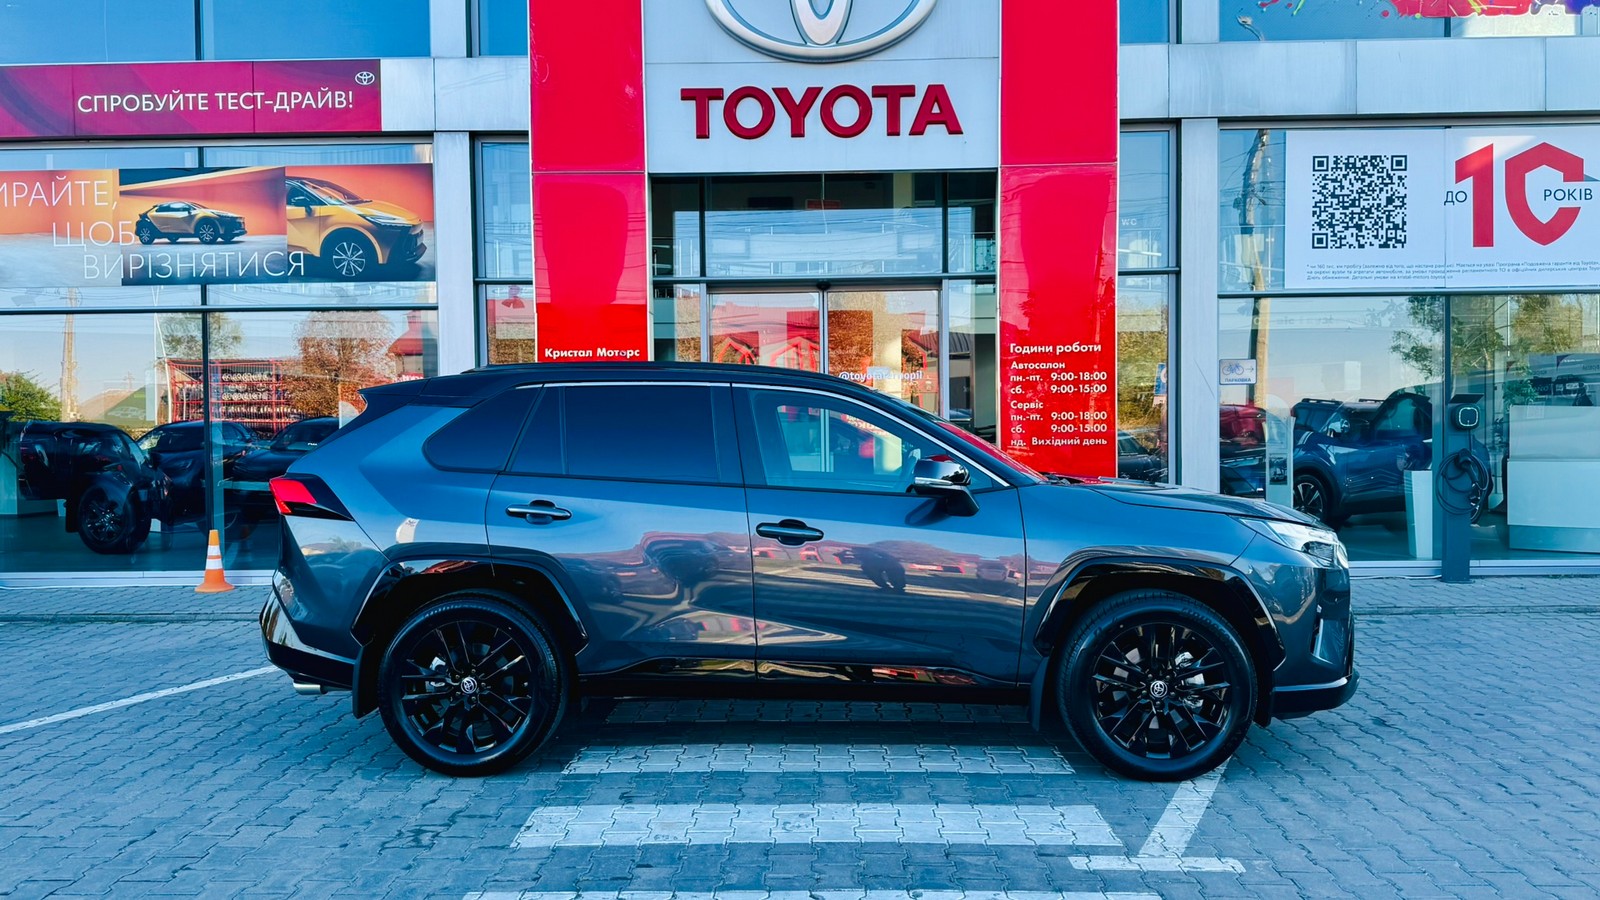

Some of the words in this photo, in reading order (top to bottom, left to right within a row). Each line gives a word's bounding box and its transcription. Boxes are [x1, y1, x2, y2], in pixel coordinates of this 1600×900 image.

[78, 89, 208, 114] СПРОБУЙТЕ
[214, 86, 353, 112] ТЕСТ-ДРАЙВ!
[680, 84, 964, 139] TOYOTA
[1444, 190, 1468, 206] ДО
[1455, 142, 1584, 248] 10
[1544, 188, 1593, 202] РОКІВ
[52, 220, 136, 252] ЩОБ
[83, 250, 305, 280] ВИРІЗНЯТИСЯ
[545, 348, 592, 359] Кристал
[596, 348, 640, 358] Моторс
[1010, 343, 1053, 354] Години
[1056, 342, 1101, 355] роботи
[1010, 361, 1065, 369] Автосалон
[1050, 371, 1107, 381] 9:00-18:00
[1010, 385, 1025, 394] сб.
[1050, 384, 1107, 393] 9:00-15:00
[1010, 400, 1044, 410] Сервіс
[1051, 411, 1107, 420] 9:00-18:00
[1010, 424, 1025, 433] сб.
[1051, 424, 1107, 433] 9:00-15:00
[1032, 436, 1080, 446] Вихідний
